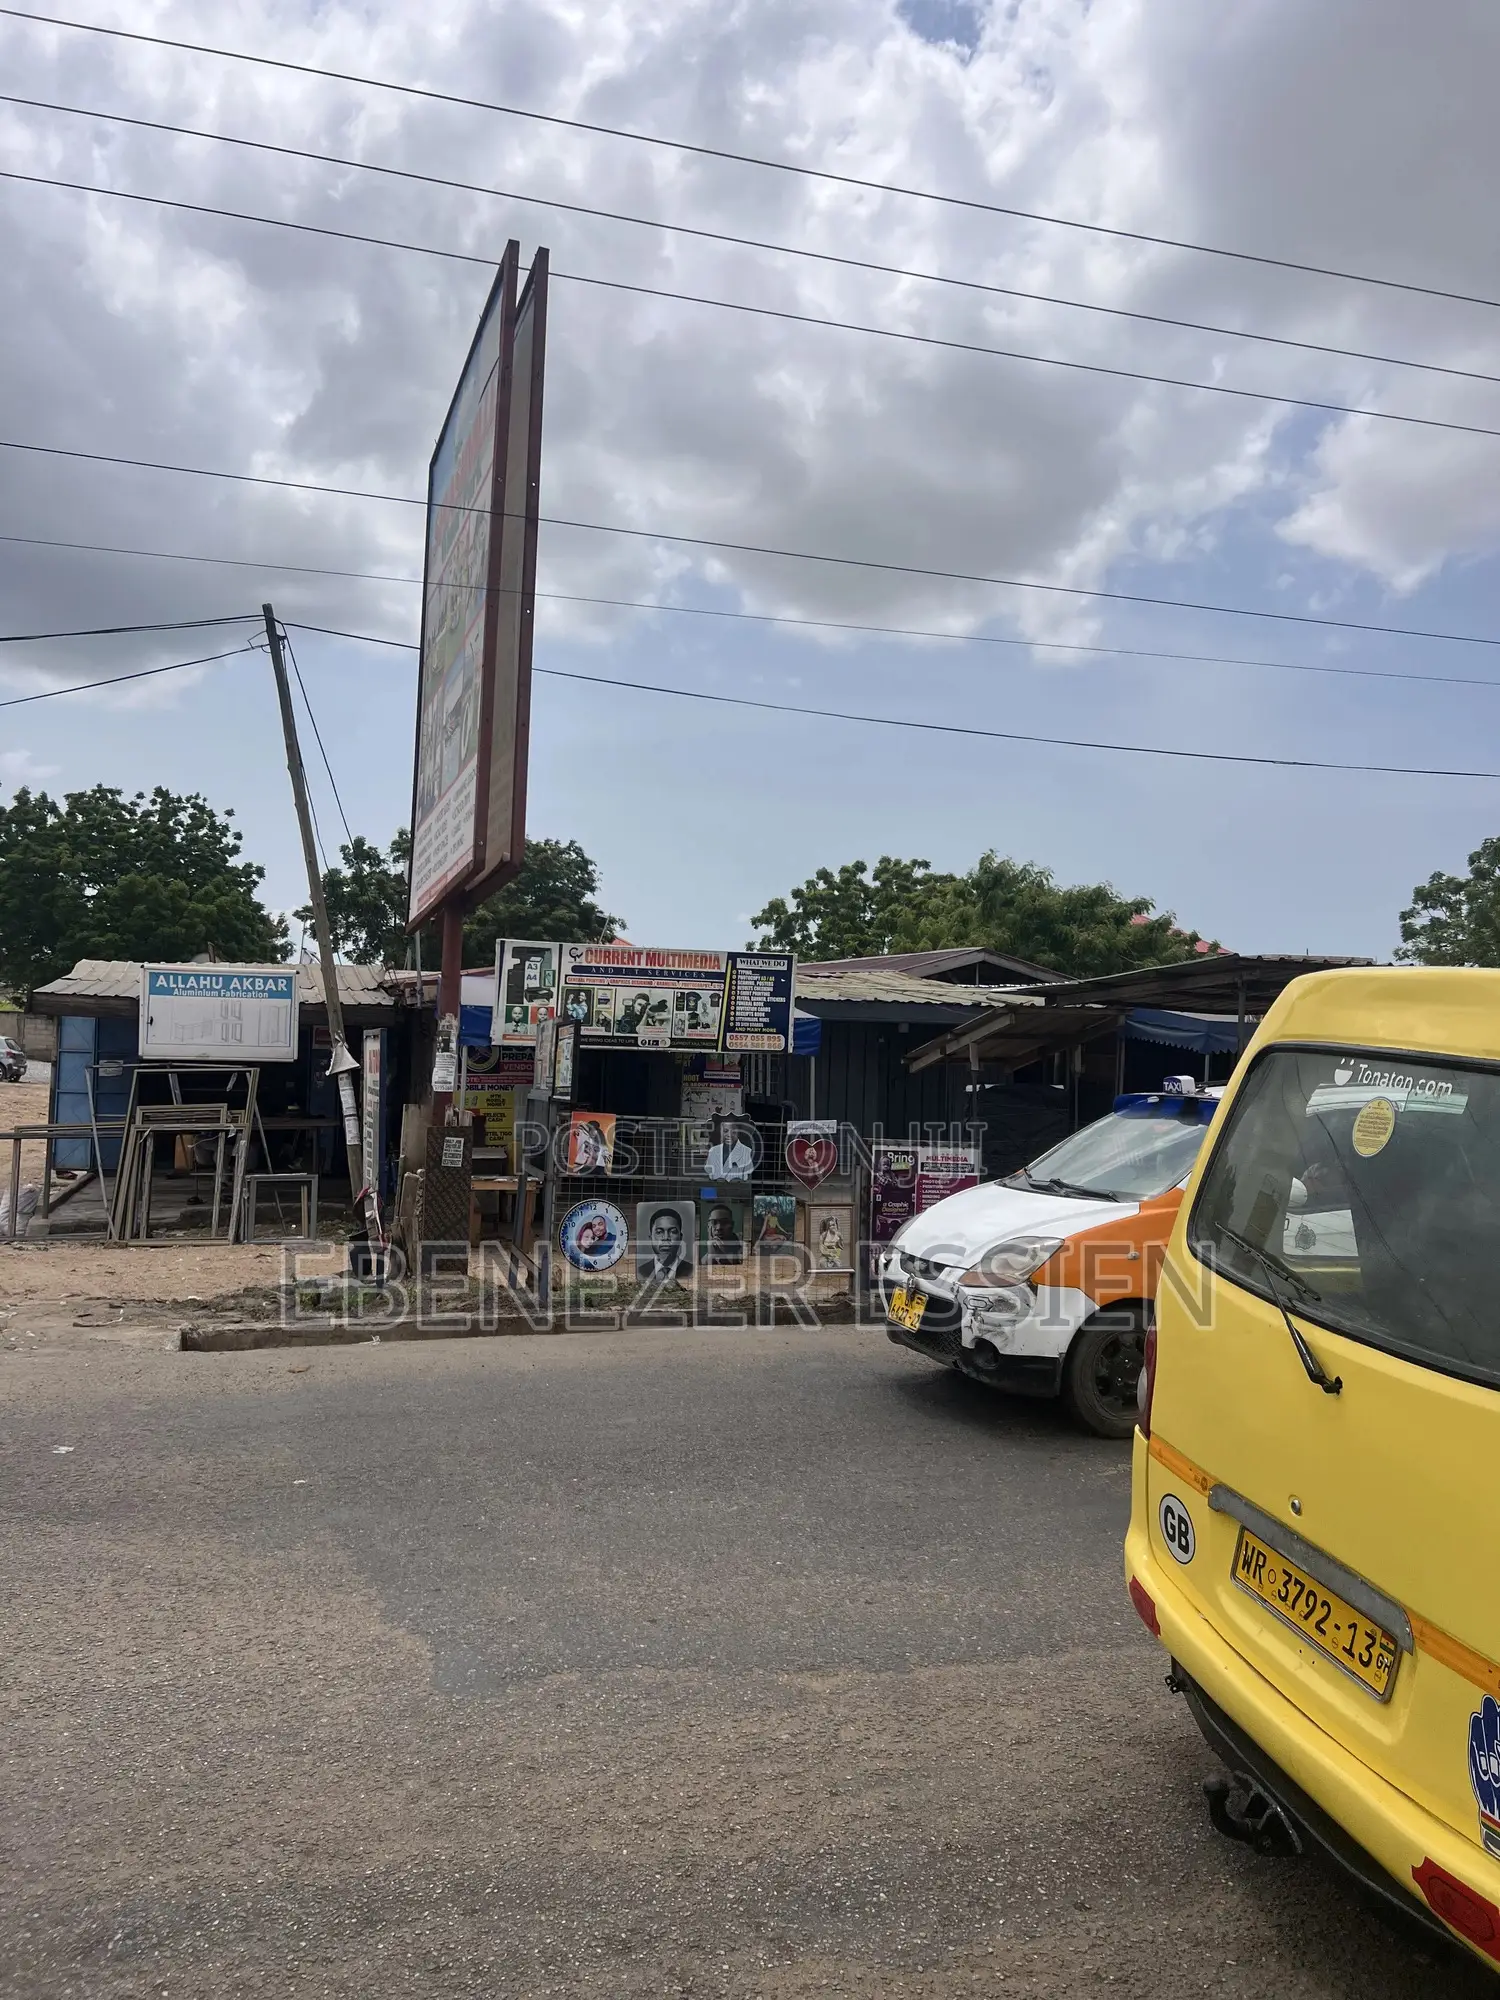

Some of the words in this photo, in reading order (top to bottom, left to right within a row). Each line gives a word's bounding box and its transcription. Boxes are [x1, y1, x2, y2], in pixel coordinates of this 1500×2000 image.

[585, 948, 643, 966] CURRENT
[645, 951, 721, 970] MULTIMEDIA
[648, 970, 706, 978] SERVICES
[156, 975, 223, 989] ALLAHU
[230, 977, 287, 991] AKBAR
[173, 988, 218, 997] Aluminium
[221, 989, 268, 999] Fabrication
[1163, 1081, 1182, 1091] TAXI
[1357, 1063, 1453, 1096] Tonaton.com
[887, 1152, 915, 1166] Bring
[888, 1201, 909, 1209] Graphic
[1163, 1504, 1190, 1555] GB
[1241, 1540, 1267, 1585] WR
[1277, 1568, 1377, 1668] 3792-13
